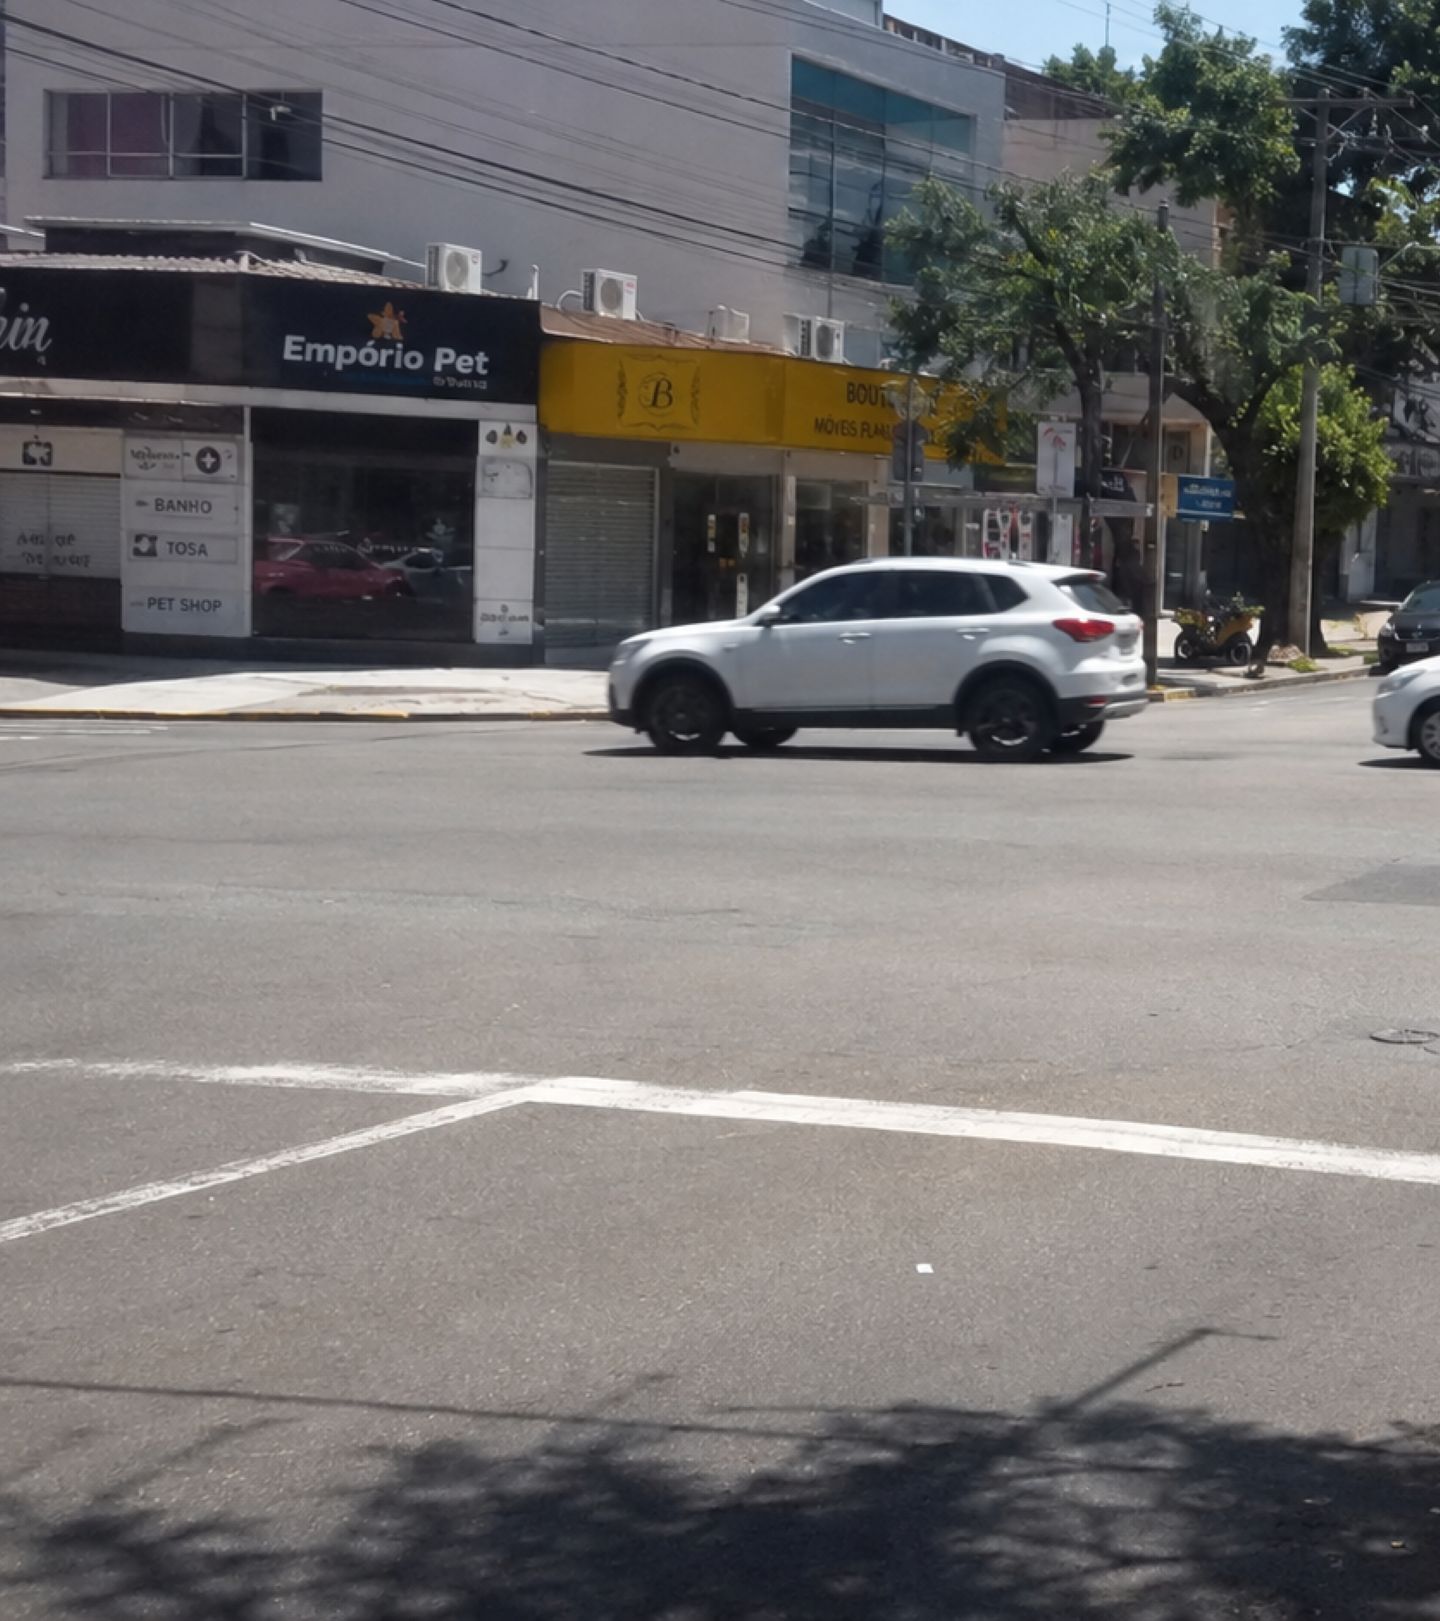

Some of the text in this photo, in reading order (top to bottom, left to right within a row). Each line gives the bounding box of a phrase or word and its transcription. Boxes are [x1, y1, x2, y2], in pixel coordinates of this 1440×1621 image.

[0, 288, 52, 352] in
[283, 334, 489, 375] Empório Pet
[650, 377, 674, 409] B
[846, 382, 895, 409] BOUT
[860, 420, 892, 441] PLAN
[154, 497, 212, 514] BANHO
[166, 541, 208, 557] TOSA
[147, 596, 222, 612] PET SHOP
